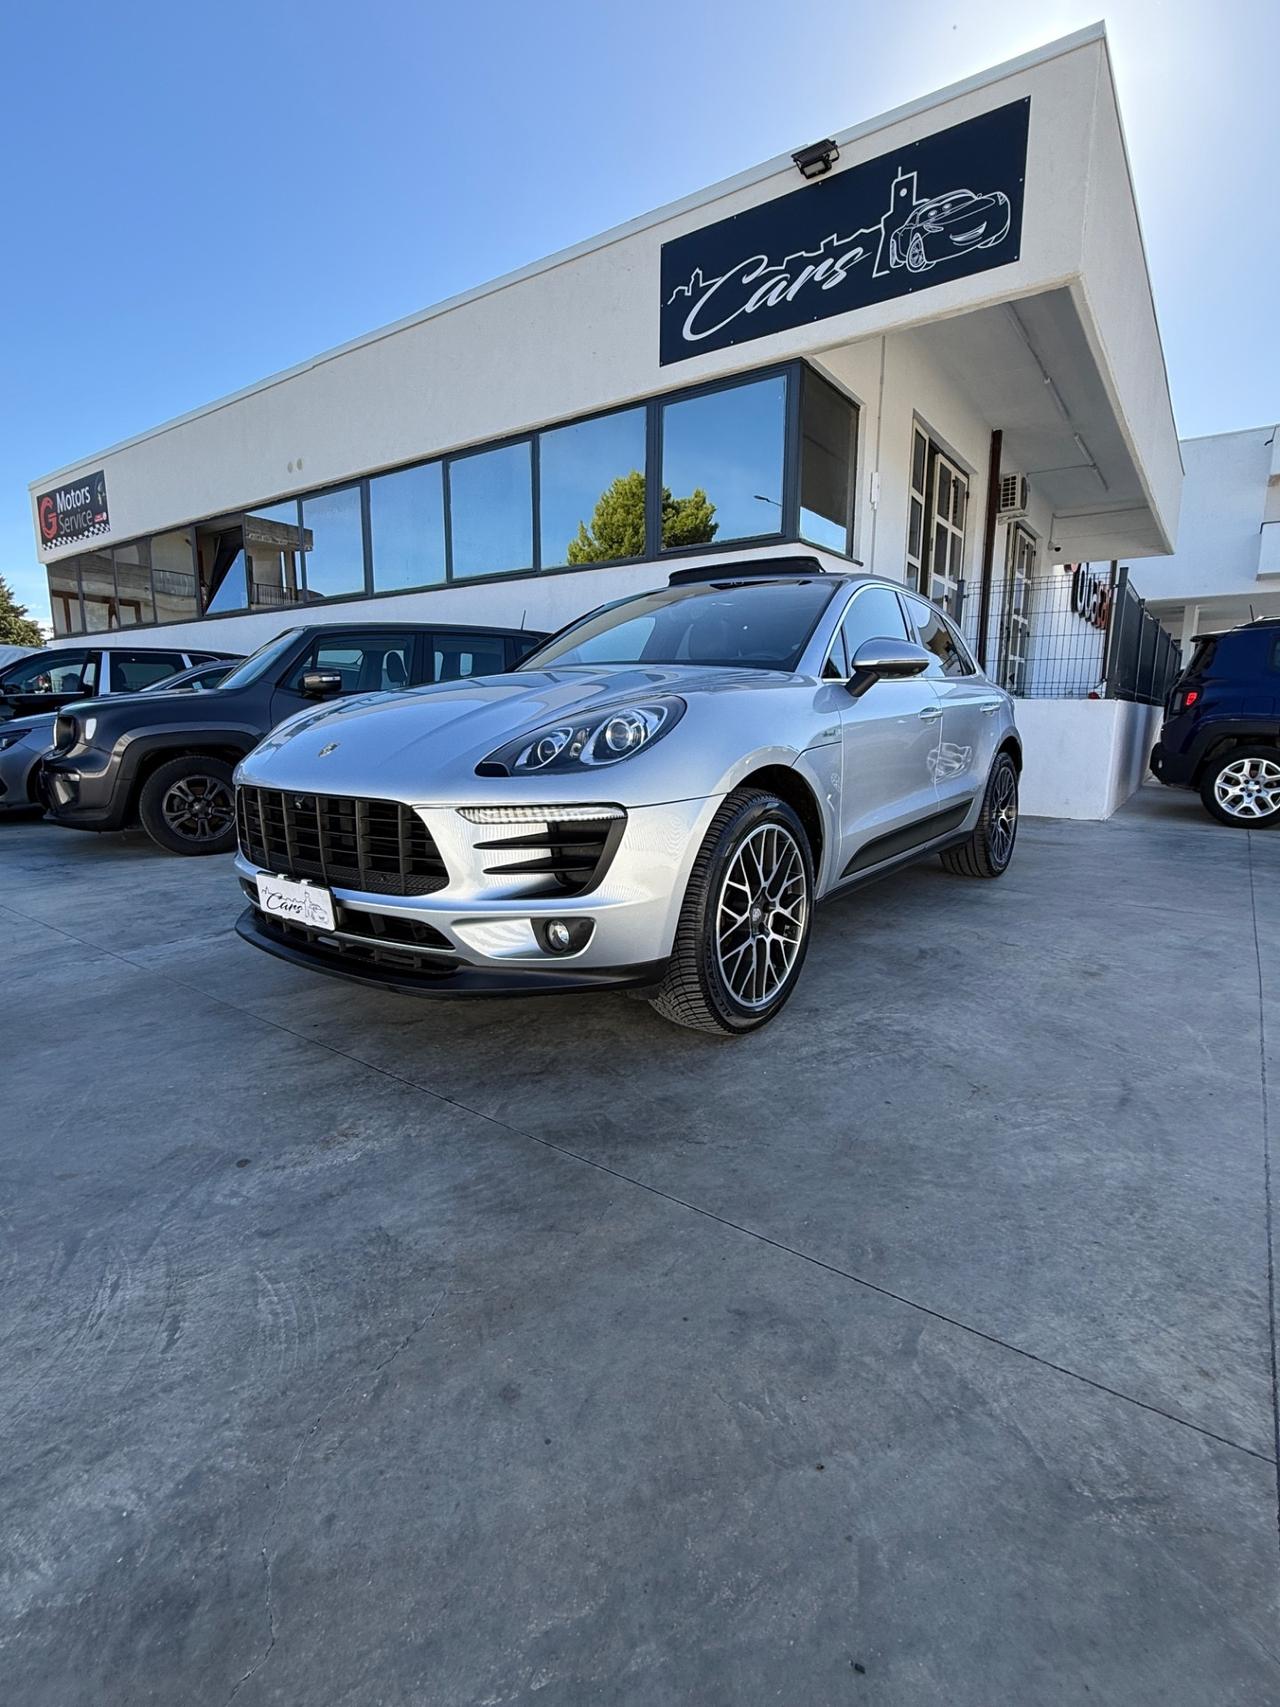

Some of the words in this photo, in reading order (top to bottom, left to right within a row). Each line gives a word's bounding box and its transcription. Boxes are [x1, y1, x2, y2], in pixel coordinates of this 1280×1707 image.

[682, 247, 872, 341] Cars
[40, 496, 58, 539] G
[56, 486, 91, 513] Motors
[58, 508, 93, 535] Service
[266, 891, 303, 914] Cars
